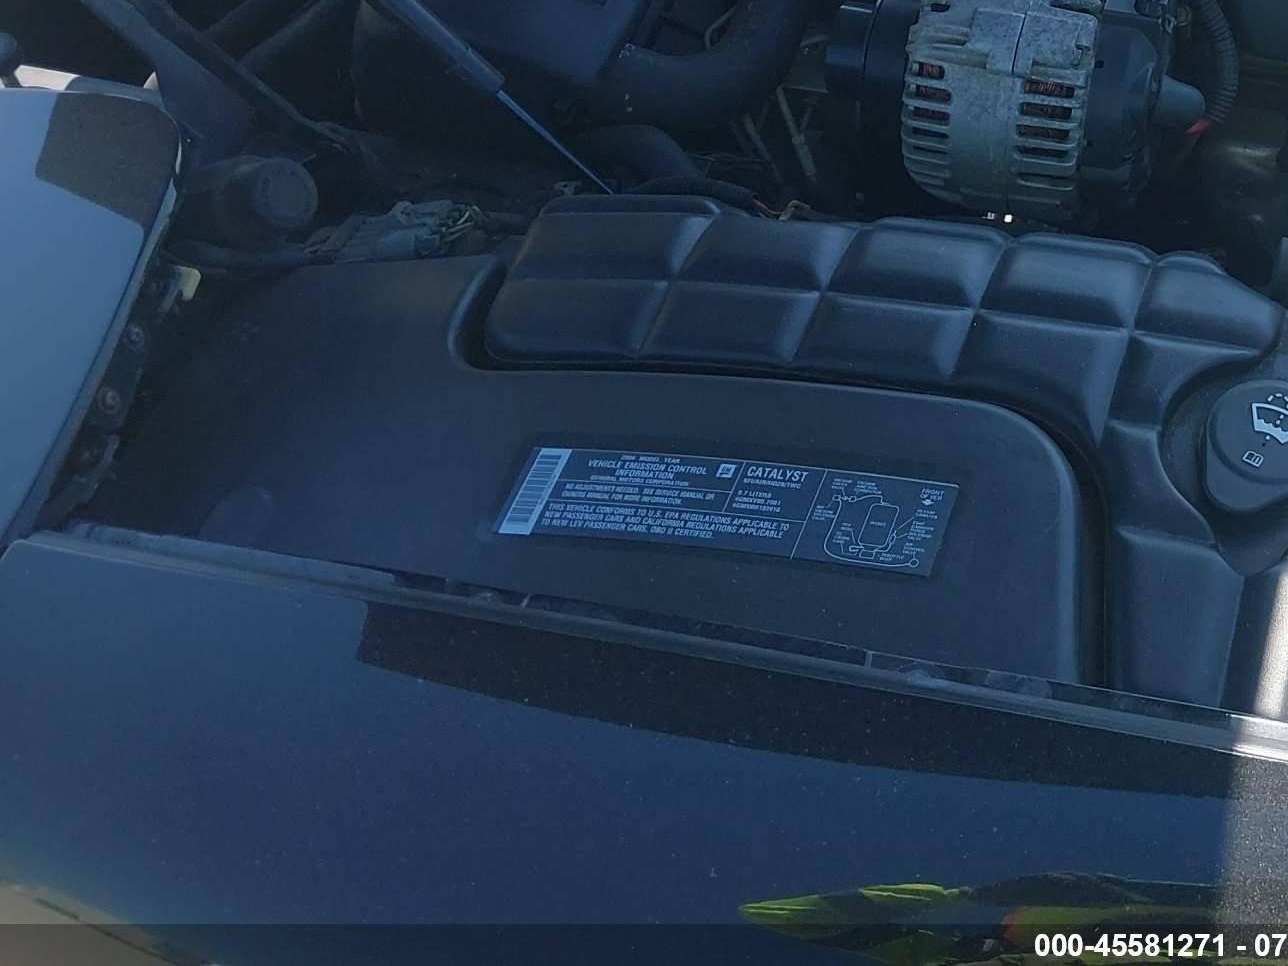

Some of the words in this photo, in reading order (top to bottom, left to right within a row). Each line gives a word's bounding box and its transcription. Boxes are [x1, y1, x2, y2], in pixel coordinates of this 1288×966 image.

[588, 459, 621, 468] VEHICLE
[624, 462, 665, 471] EMISSION
[667, 464, 707, 475] CONTROL
[615, 469, 674, 479] INFORMATION
[747, 466, 809, 483] CATALYST
[680, 491, 704, 499] MANUAL
[749, 490, 772, 499] LITERS
[921, 488, 944, 496] FRONT
[544, 510, 562, 518] NEW
[561, 511, 603, 521] PASSENGER
[604, 514, 624, 523] CARS
[624, 516, 642, 525] AND
[642, 517, 685, 528] CALIFORNIA
[685, 521, 737, 533] REGULATIONS
[737, 527, 784, 539] APPLICABLE
[549, 503, 565, 511] THIS
[566, 503, 595, 512] VEHICLE
[596, 505, 636, 515] CONFORMS
[649, 510, 661, 518] U.S.
[664, 511, 680, 519] EPA
[681, 513, 733, 525] REGULATIONS
[733, 518, 778, 529] APPLICABLE
[779, 523, 790, 531] TO
[541, 518, 551, 526] TO
[551, 518, 569, 527] NEW
[569, 520, 583, 528] LEV
[583, 520, 625, 531] PASSENGER
[626, 524, 648, 533] CARS.
[650, 526, 667, 534] OBD
[673, 528, 714, 539] CERTIFIED.
